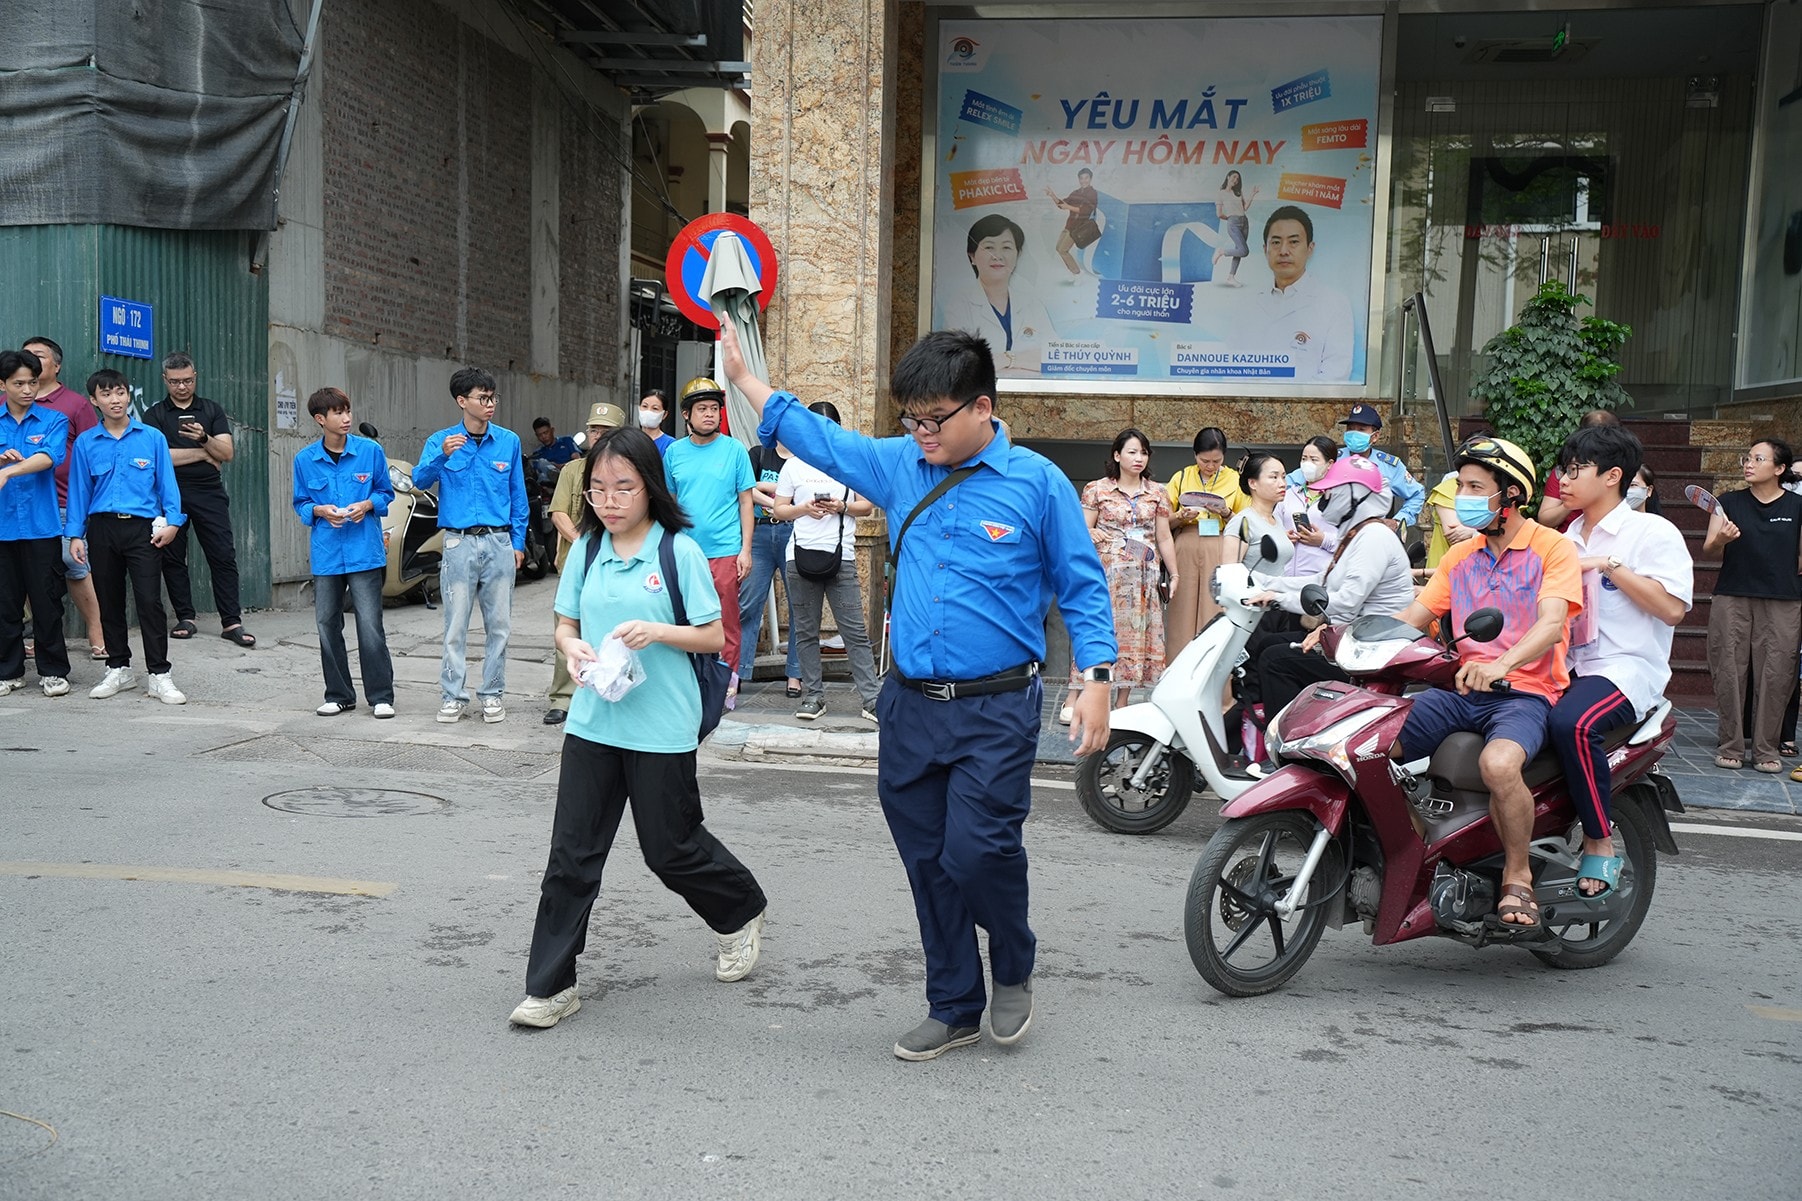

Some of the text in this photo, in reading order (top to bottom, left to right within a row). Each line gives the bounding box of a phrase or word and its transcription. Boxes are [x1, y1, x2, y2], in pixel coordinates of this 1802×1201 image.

[1281, 86, 1322, 107] 1X TRIỆU
[1059, 84, 1248, 130] YÊU MẮT
[966, 107, 1016, 130] RELEX SMILE
[1317, 134, 1347, 144] FEMTO
[1020, 134, 1287, 165] NGAY HÔM NAY
[959, 183, 1020, 200] PHAKIC ICL
[1282, 185, 1300, 194] MIỄN
[1302, 188, 1314, 196] PHÍ
[1320, 191, 1340, 201] NĂM
[1118, 284, 1174, 296] Ưu đãi cực lớn
[1111, 294, 1180, 311] 2-6 TRIỆU
[113, 304, 141, 328] NGÕ 172
[1132, 309, 1152, 317] người
[107, 332, 149, 351] PHỐ THÁI THỊNH
[1048, 349, 1131, 362] LÊ THÚY QUỲNH
[1177, 353, 1289, 364] DANNOUE KAZUHIKO
[1064, 364, 1075, 372] đốc
[1076, 365, 1097, 373] chuyên
[1243, 368, 1258, 376] Nhật
[1356, 752, 1386, 762] HONDA
